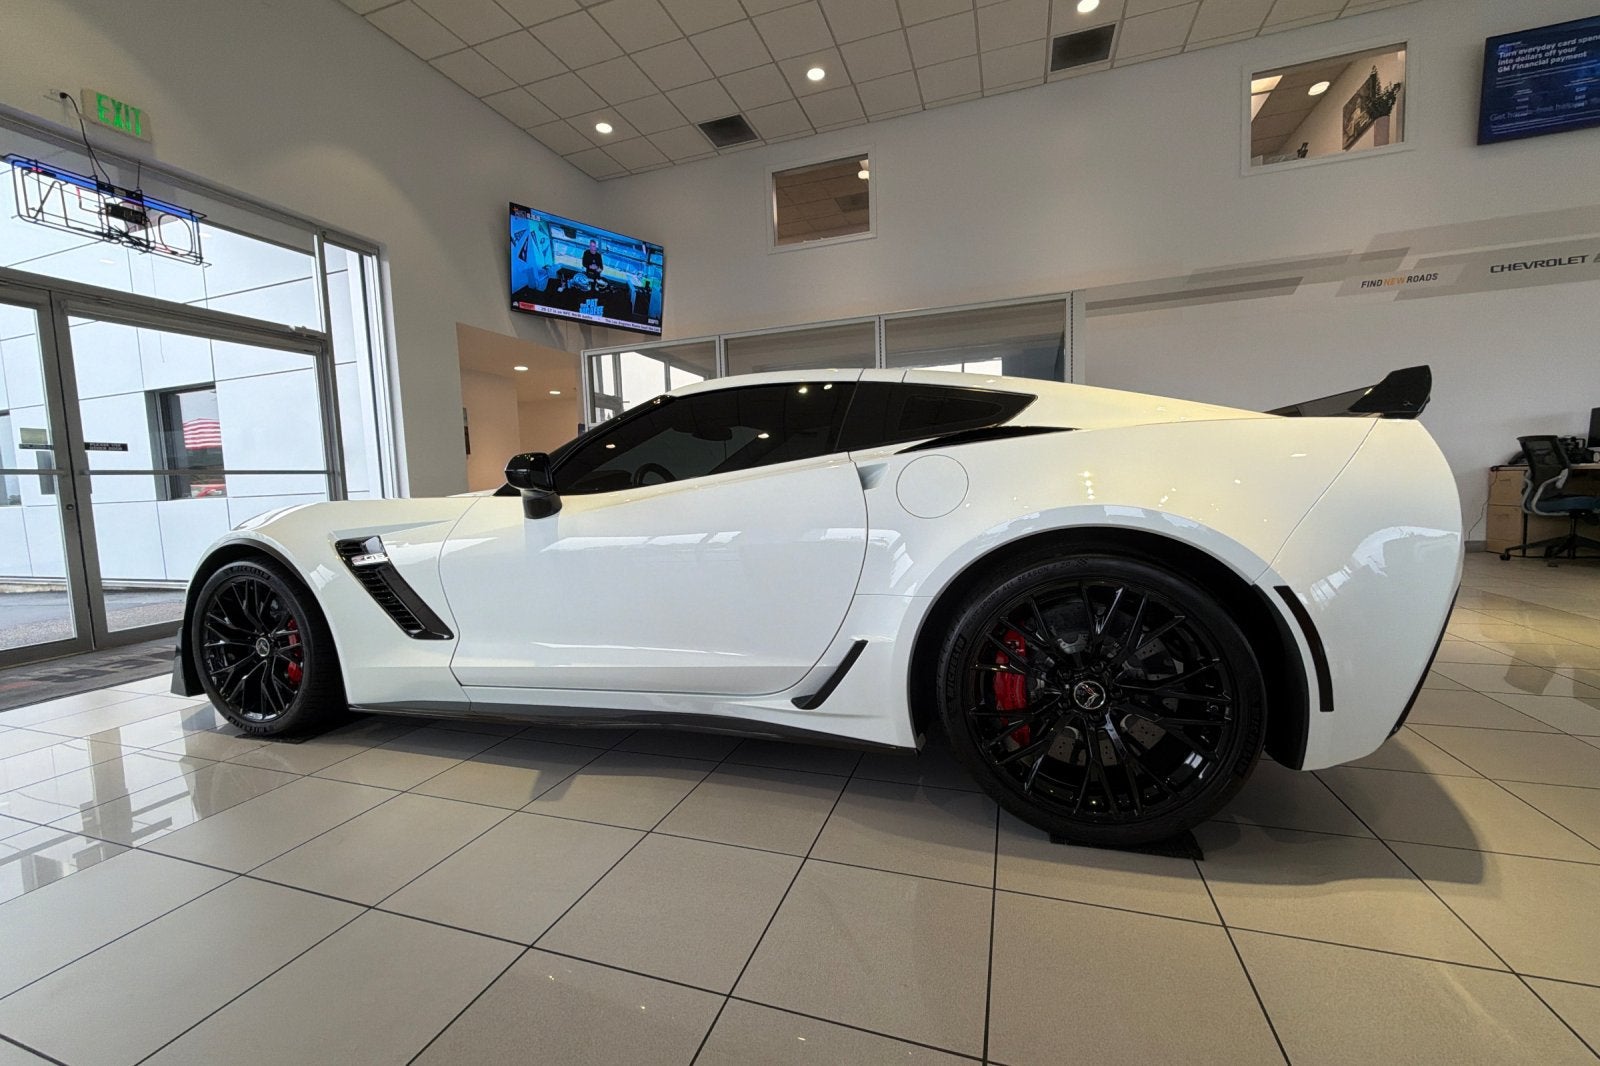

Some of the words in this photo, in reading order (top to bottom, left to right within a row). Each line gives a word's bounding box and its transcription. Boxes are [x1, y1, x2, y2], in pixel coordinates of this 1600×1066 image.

[1498, 58, 1514, 66] into
[1515, 52, 1543, 63] dollars
[1558, 46, 1577, 55] your
[1499, 50, 1517, 59] Turn
[1518, 43, 1556, 54] everyday
[1557, 38, 1577, 48] card
[1497, 65, 1511, 73] GM
[1511, 58, 1550, 71] Financial
[1550, 51, 1588, 64] payment
[96, 92, 142, 137] EXIT
[1490, 254, 1590, 274] CHEVROLET
[1361, 279, 1383, 288] FIND
[1383, 276, 1405, 286] NEW
[1406, 272, 1439, 283] ROADS
